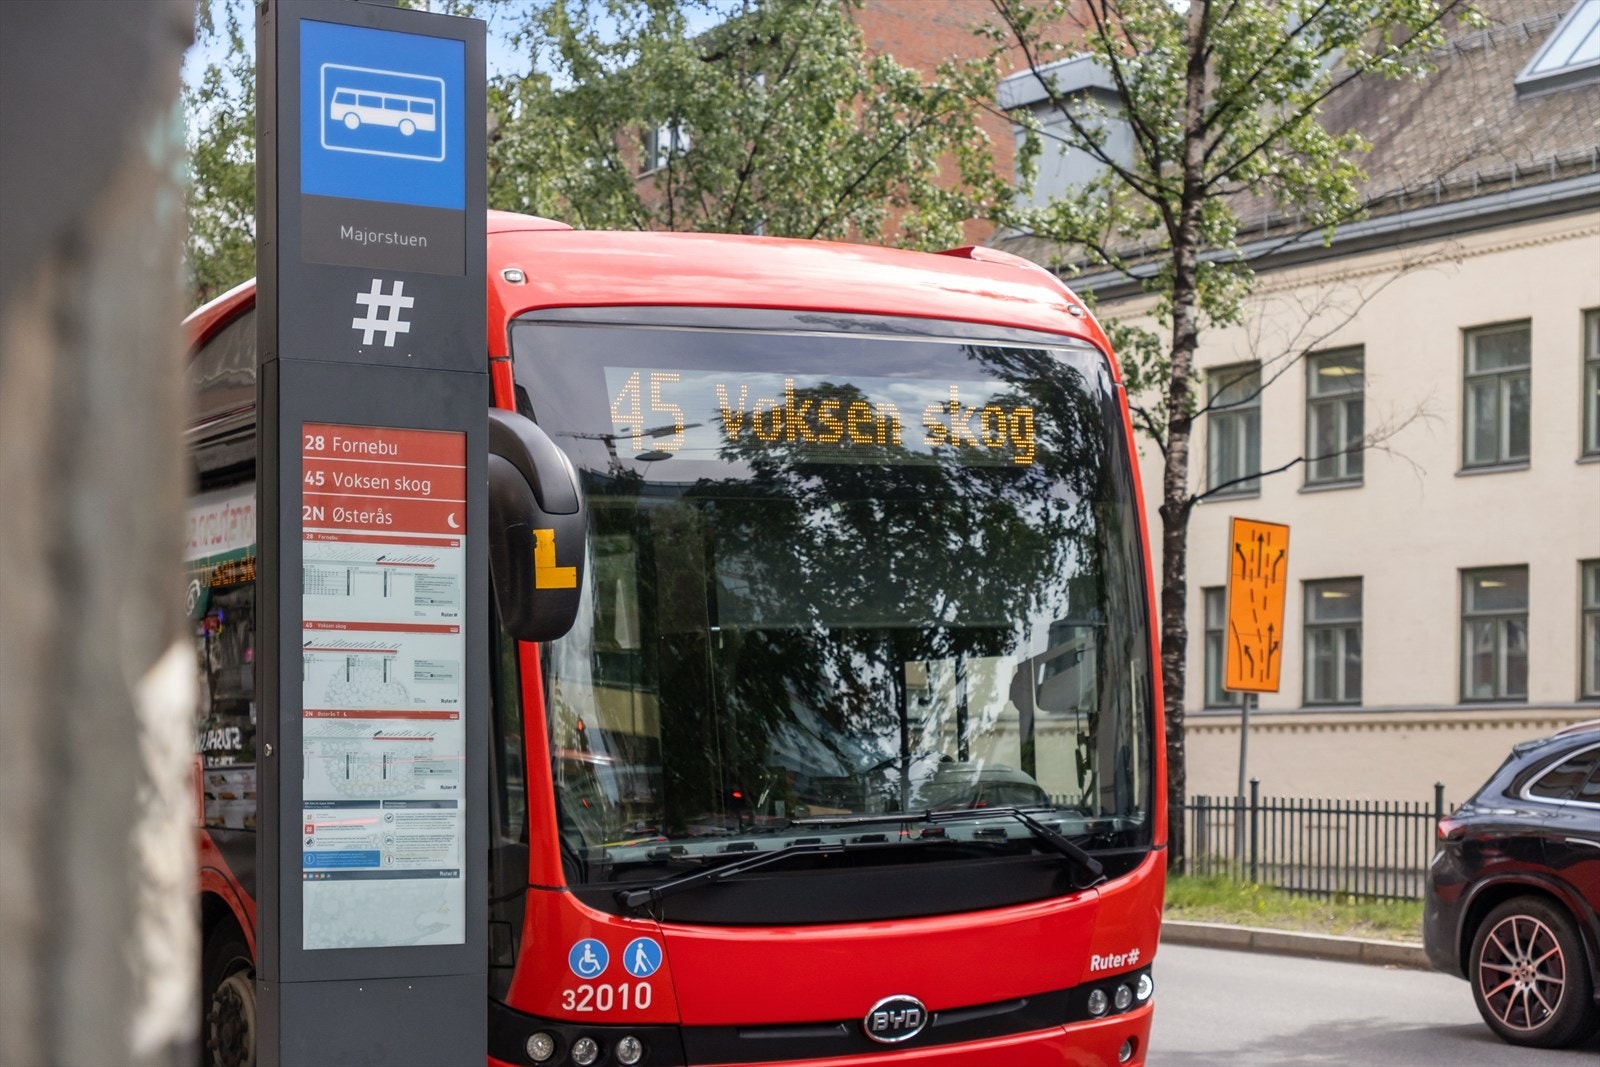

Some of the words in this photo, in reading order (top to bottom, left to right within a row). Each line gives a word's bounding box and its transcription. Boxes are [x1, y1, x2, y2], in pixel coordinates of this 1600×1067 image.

[340, 225, 428, 248] Majorstuen
[610, 371, 685, 452] 45
[715, 377, 902, 445] Voksen
[922, 385, 1036, 465] skog
[304, 435, 325, 450] 28
[333, 437, 398, 456] Fornebu
[304, 471, 325, 486] 45
[332, 472, 390, 490] Voksen
[394, 476, 431, 496] skog
[302, 506, 325, 521] 2N
[332, 507, 393, 525] Østerås
[561, 981, 652, 1012] 32010
[872, 1008, 922, 1031] BYD
